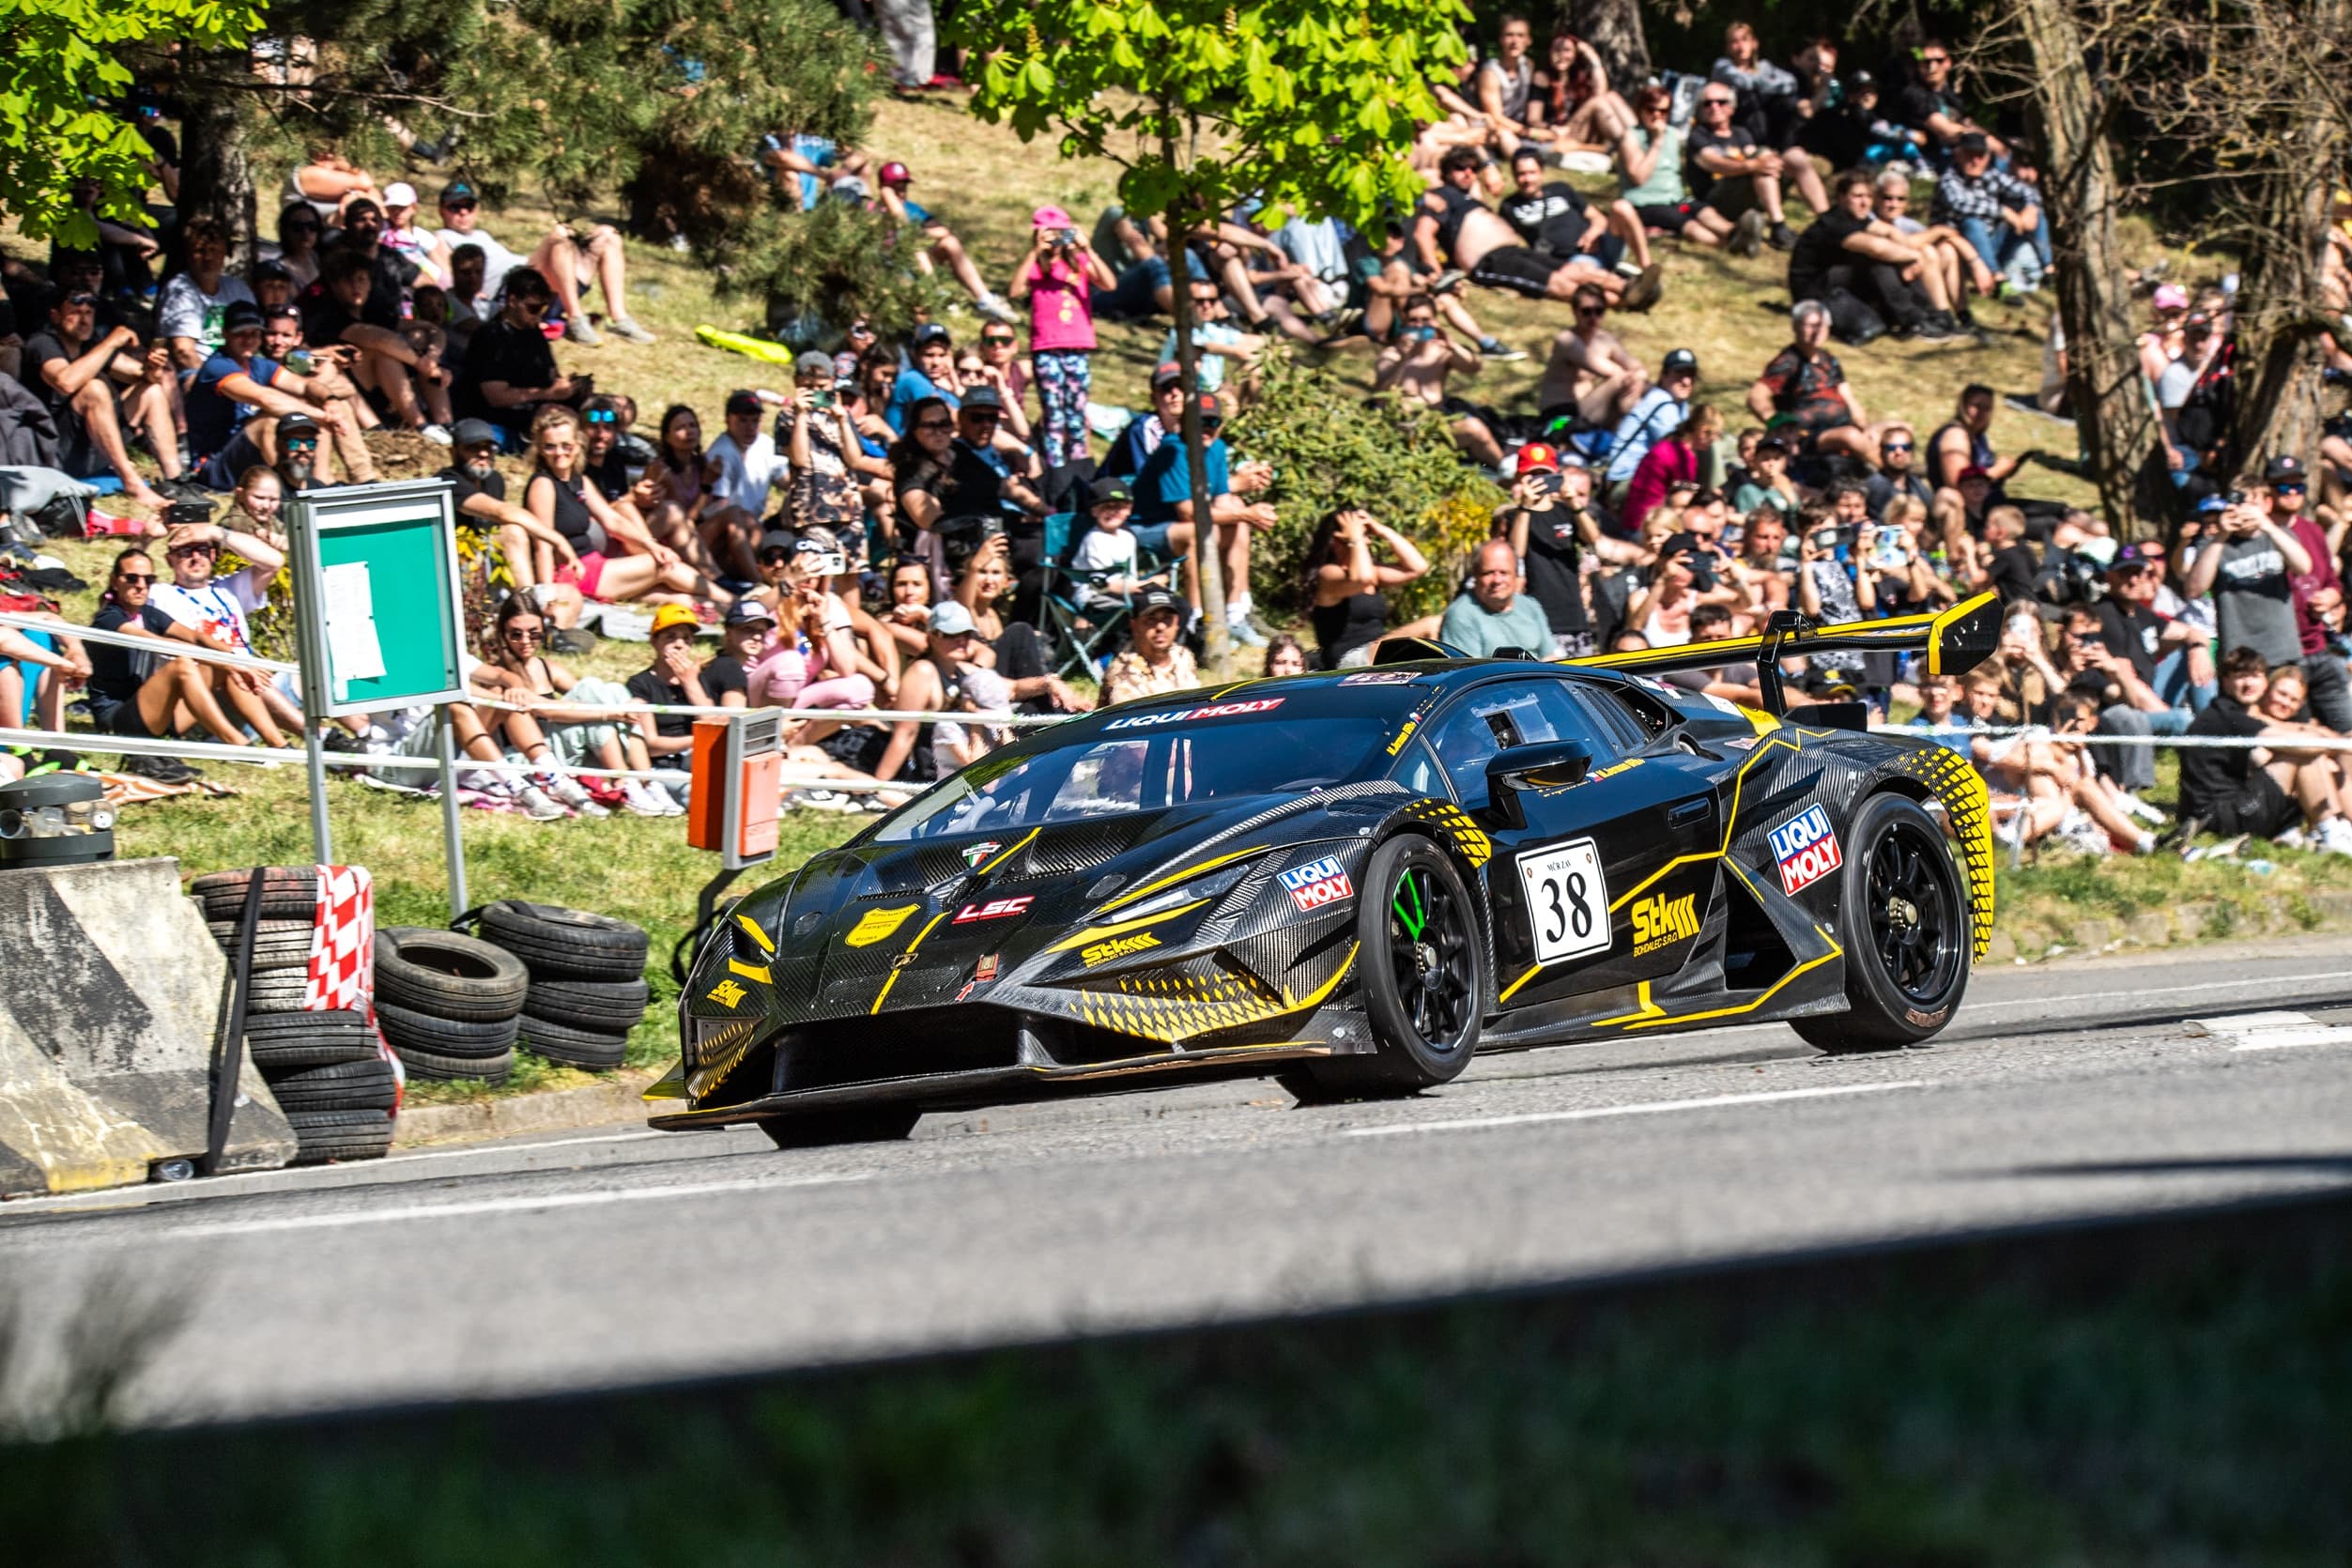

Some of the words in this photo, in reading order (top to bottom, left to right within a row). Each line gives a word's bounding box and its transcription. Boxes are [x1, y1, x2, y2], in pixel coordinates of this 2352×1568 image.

[1105, 711, 1193, 730] LIQUI
[1191, 699, 1286, 718] MOLY
[1772, 807, 1830, 861] LIQUI
[1281, 857, 1342, 890] LIQUI
[1782, 836, 1837, 892] MOLY
[1294, 875, 1348, 909] MOLY
[1541, 871, 1592, 944] 38
[1634, 937, 1663, 958] BOHDALEC
